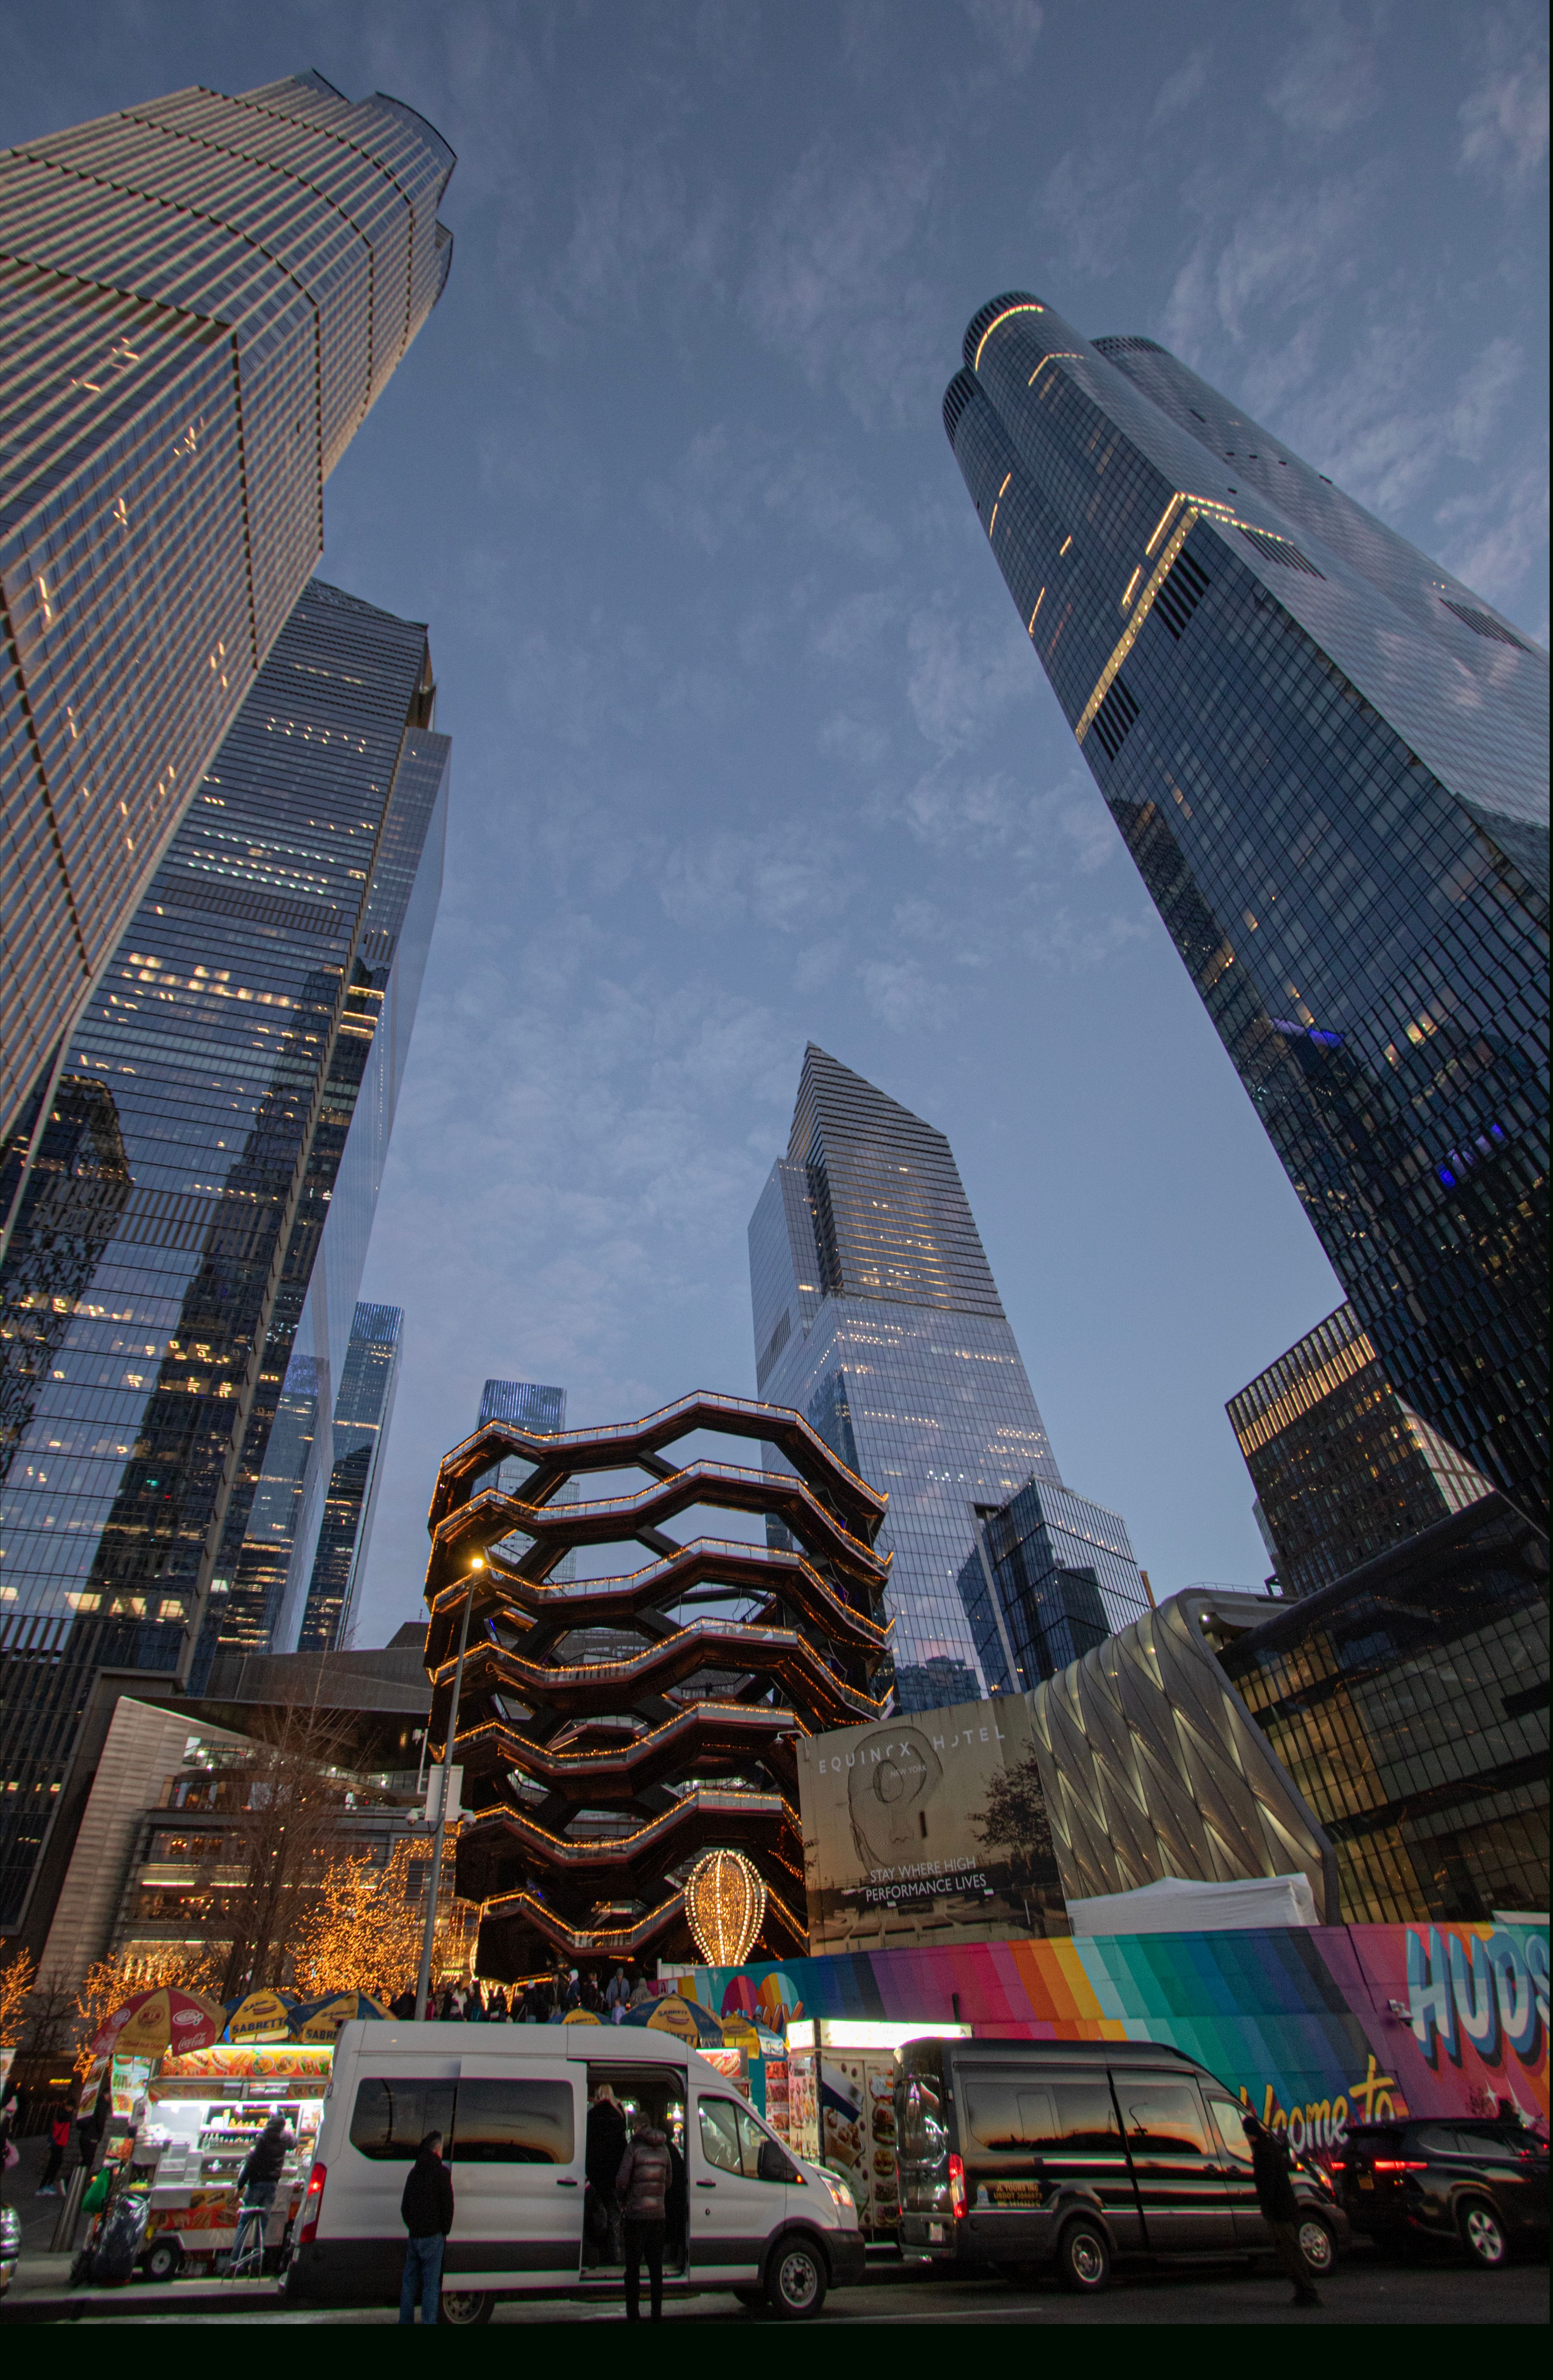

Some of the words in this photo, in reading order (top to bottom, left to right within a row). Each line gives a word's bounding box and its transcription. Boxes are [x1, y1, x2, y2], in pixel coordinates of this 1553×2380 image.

[890, 1768, 906, 1777] NEW
[909, 1764, 927, 1774] YORK
[871, 1867, 895, 1884] STAY
[898, 1861, 942, 1878] WHERE
[944, 1856, 977, 1872] HIGH
[866, 1878, 952, 1902] PERFORMANCE
[955, 1873, 987, 1890] LIVES
[232, 2018, 284, 2034] SABRETT
[306, 2029, 338, 2039] SABRE
